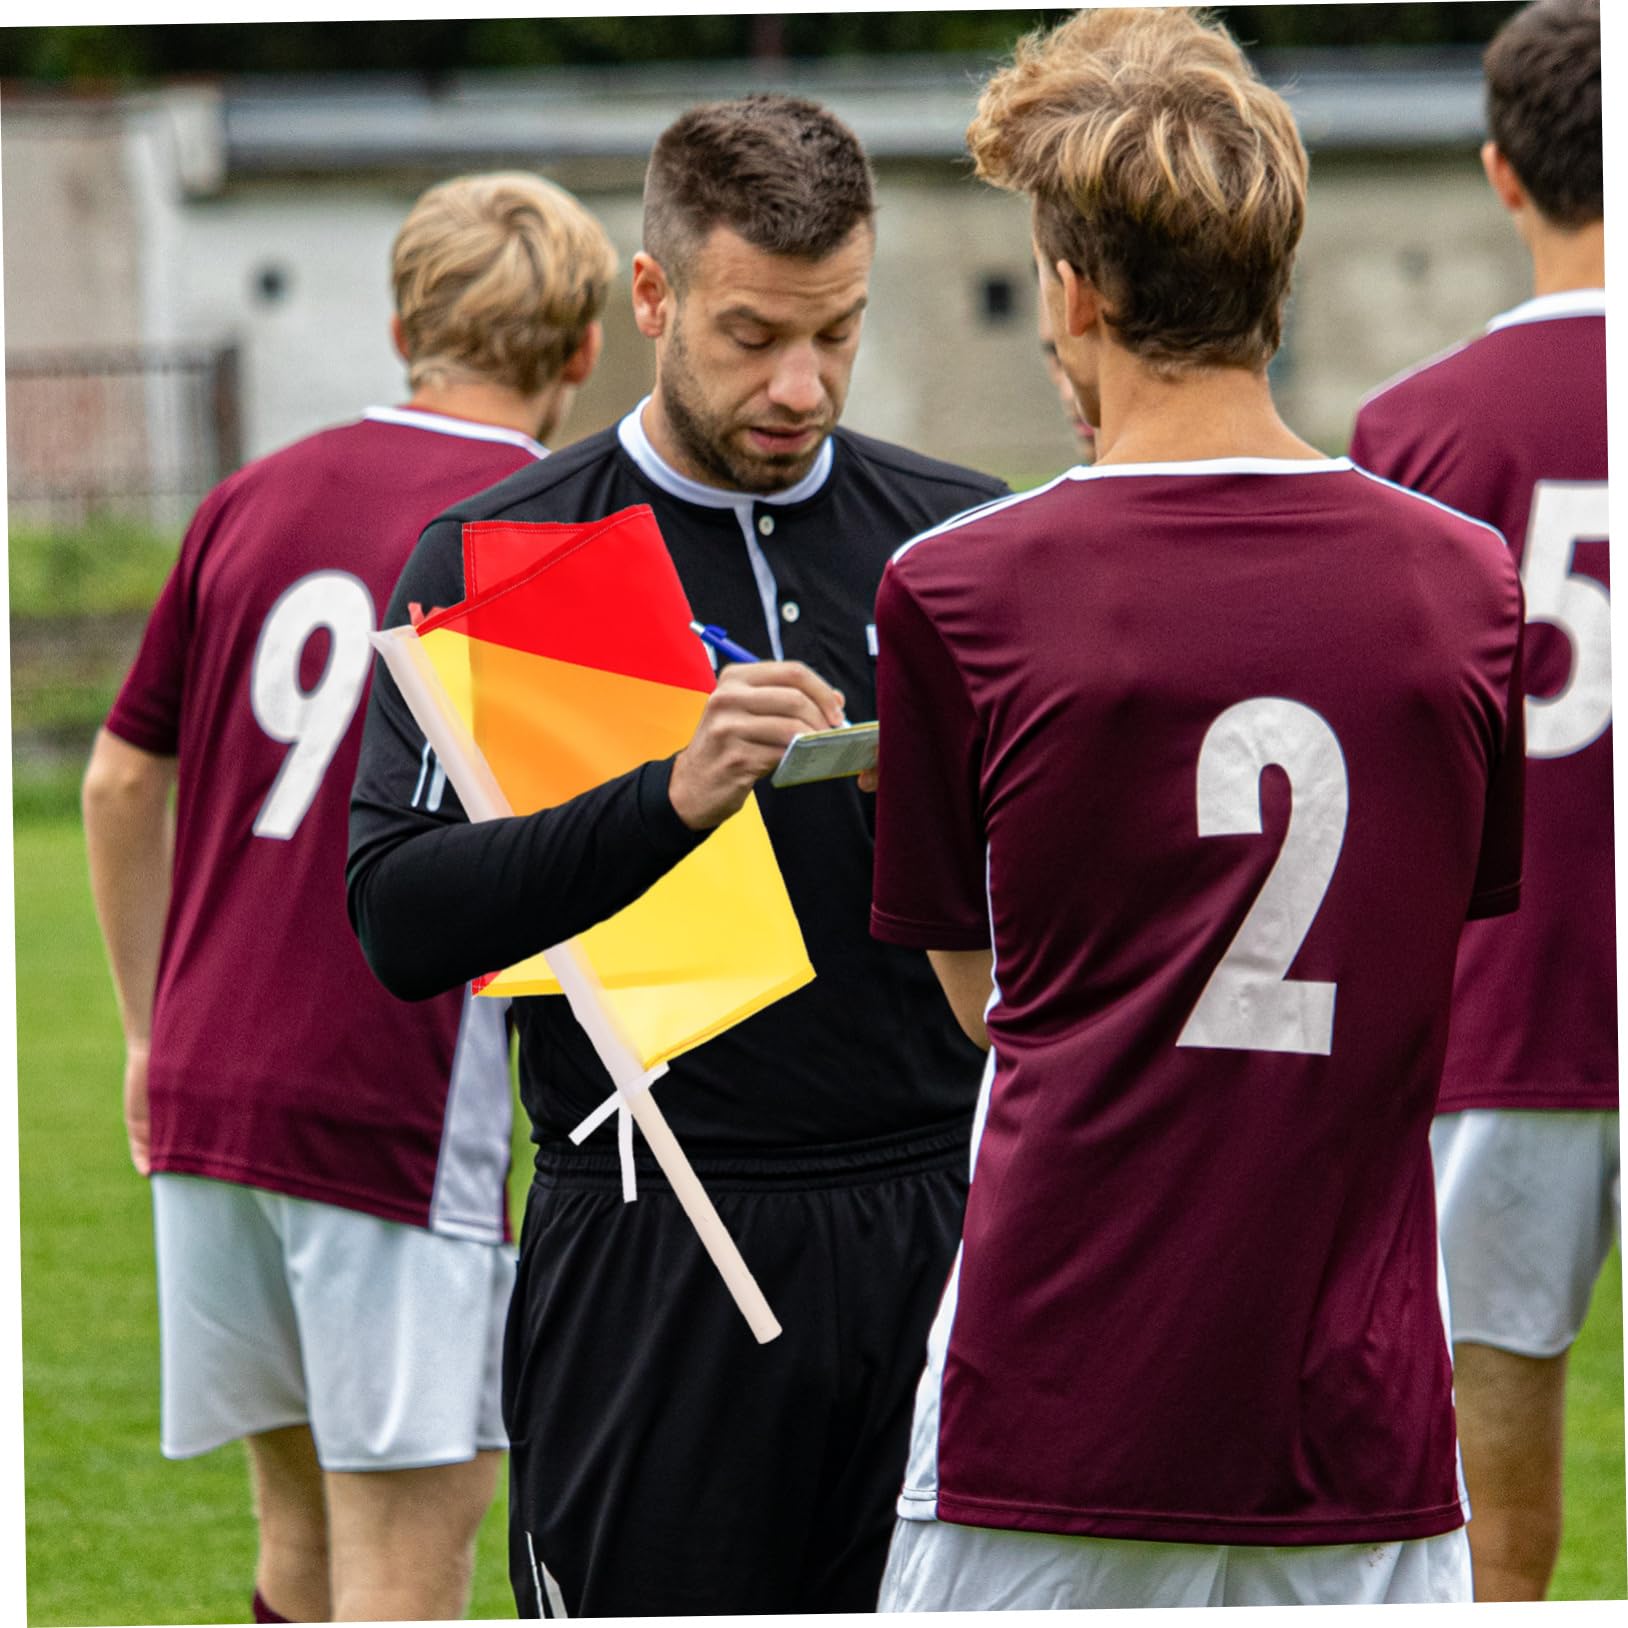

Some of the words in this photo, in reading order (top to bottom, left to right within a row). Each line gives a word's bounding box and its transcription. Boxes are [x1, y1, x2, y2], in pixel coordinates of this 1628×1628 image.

[251, 570, 375, 840] 9
[1523, 480, 1612, 758] 5
[1176, 697, 1349, 1055] 2
